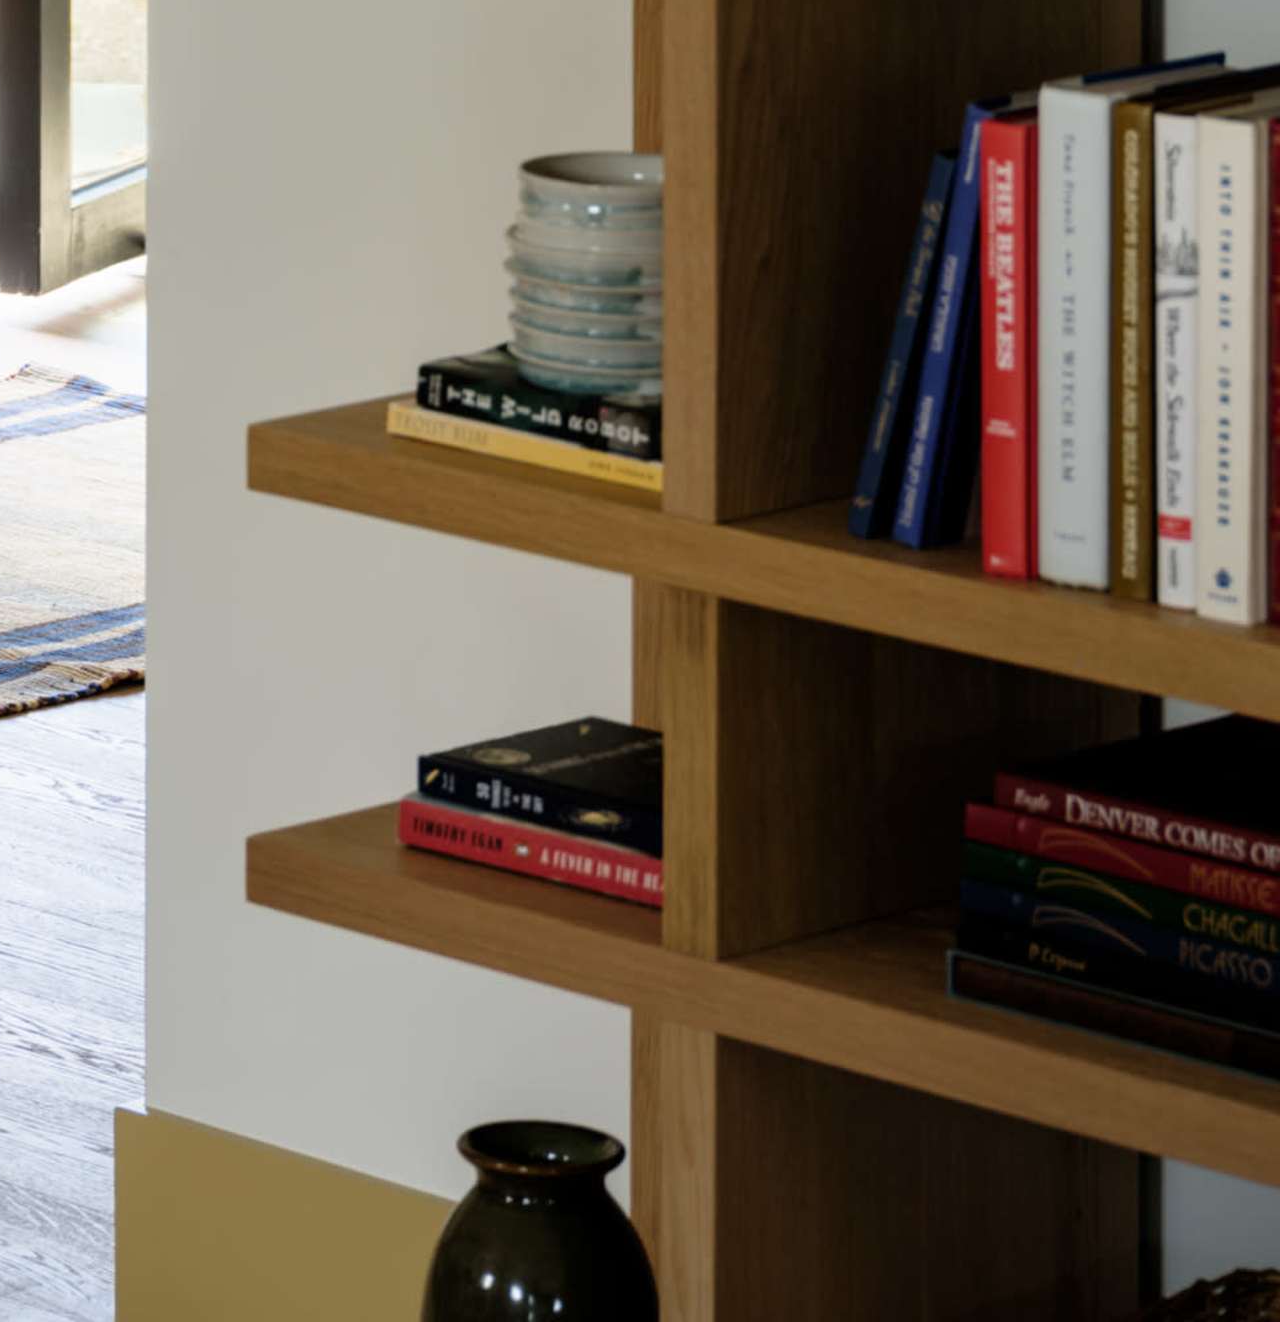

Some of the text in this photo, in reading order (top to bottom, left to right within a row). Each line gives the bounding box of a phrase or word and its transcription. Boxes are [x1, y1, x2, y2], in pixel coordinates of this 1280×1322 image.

[1218, 164, 1232, 217] INTO
[995, 159, 1016, 372] THE BEATLES
[1062, 295, 1075, 336] THE
[1218, 293, 1232, 329] AIR
[1061, 351, 1075, 427] WITCH
[446, 385, 493, 411] THE
[500, 394, 563, 428] WILD
[567, 415, 650, 445] ROBOT
[1061, 437, 1075, 483] ELM
[1064, 793, 1160, 843] DENVER
[1164, 821, 1244, 858] COMES
[412, 817, 664, 893] TIMOTHY EGAN A FEVER IN THE HE
[1189, 862, 1276, 905] MATISSE
[1183, 904, 1280, 952] CHAGALL
[1178, 939, 1273, 989] PICASSO
